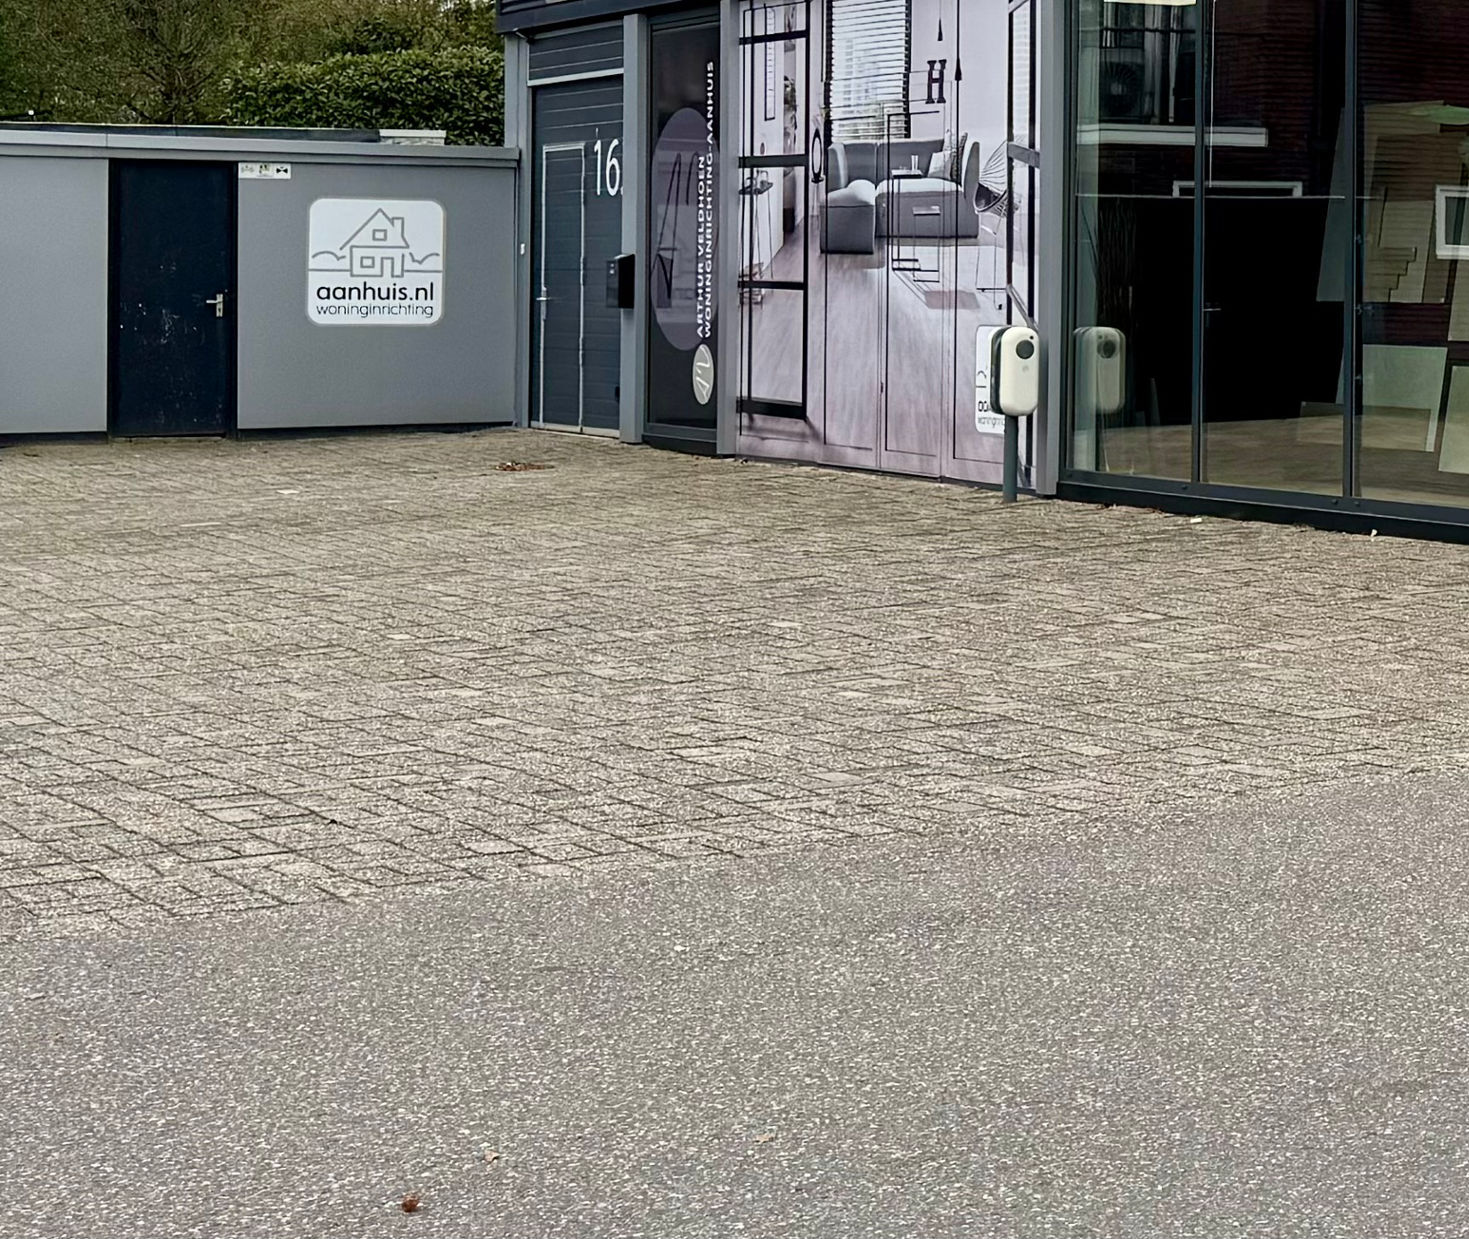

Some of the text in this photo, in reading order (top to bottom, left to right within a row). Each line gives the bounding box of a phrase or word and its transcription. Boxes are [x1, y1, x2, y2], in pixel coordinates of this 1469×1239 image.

[696, 155, 705, 339] ARTHUR VELDHOEN
[316, 280, 434, 301] aanhuis.nl
[316, 303, 434, 318] woninginrichting
